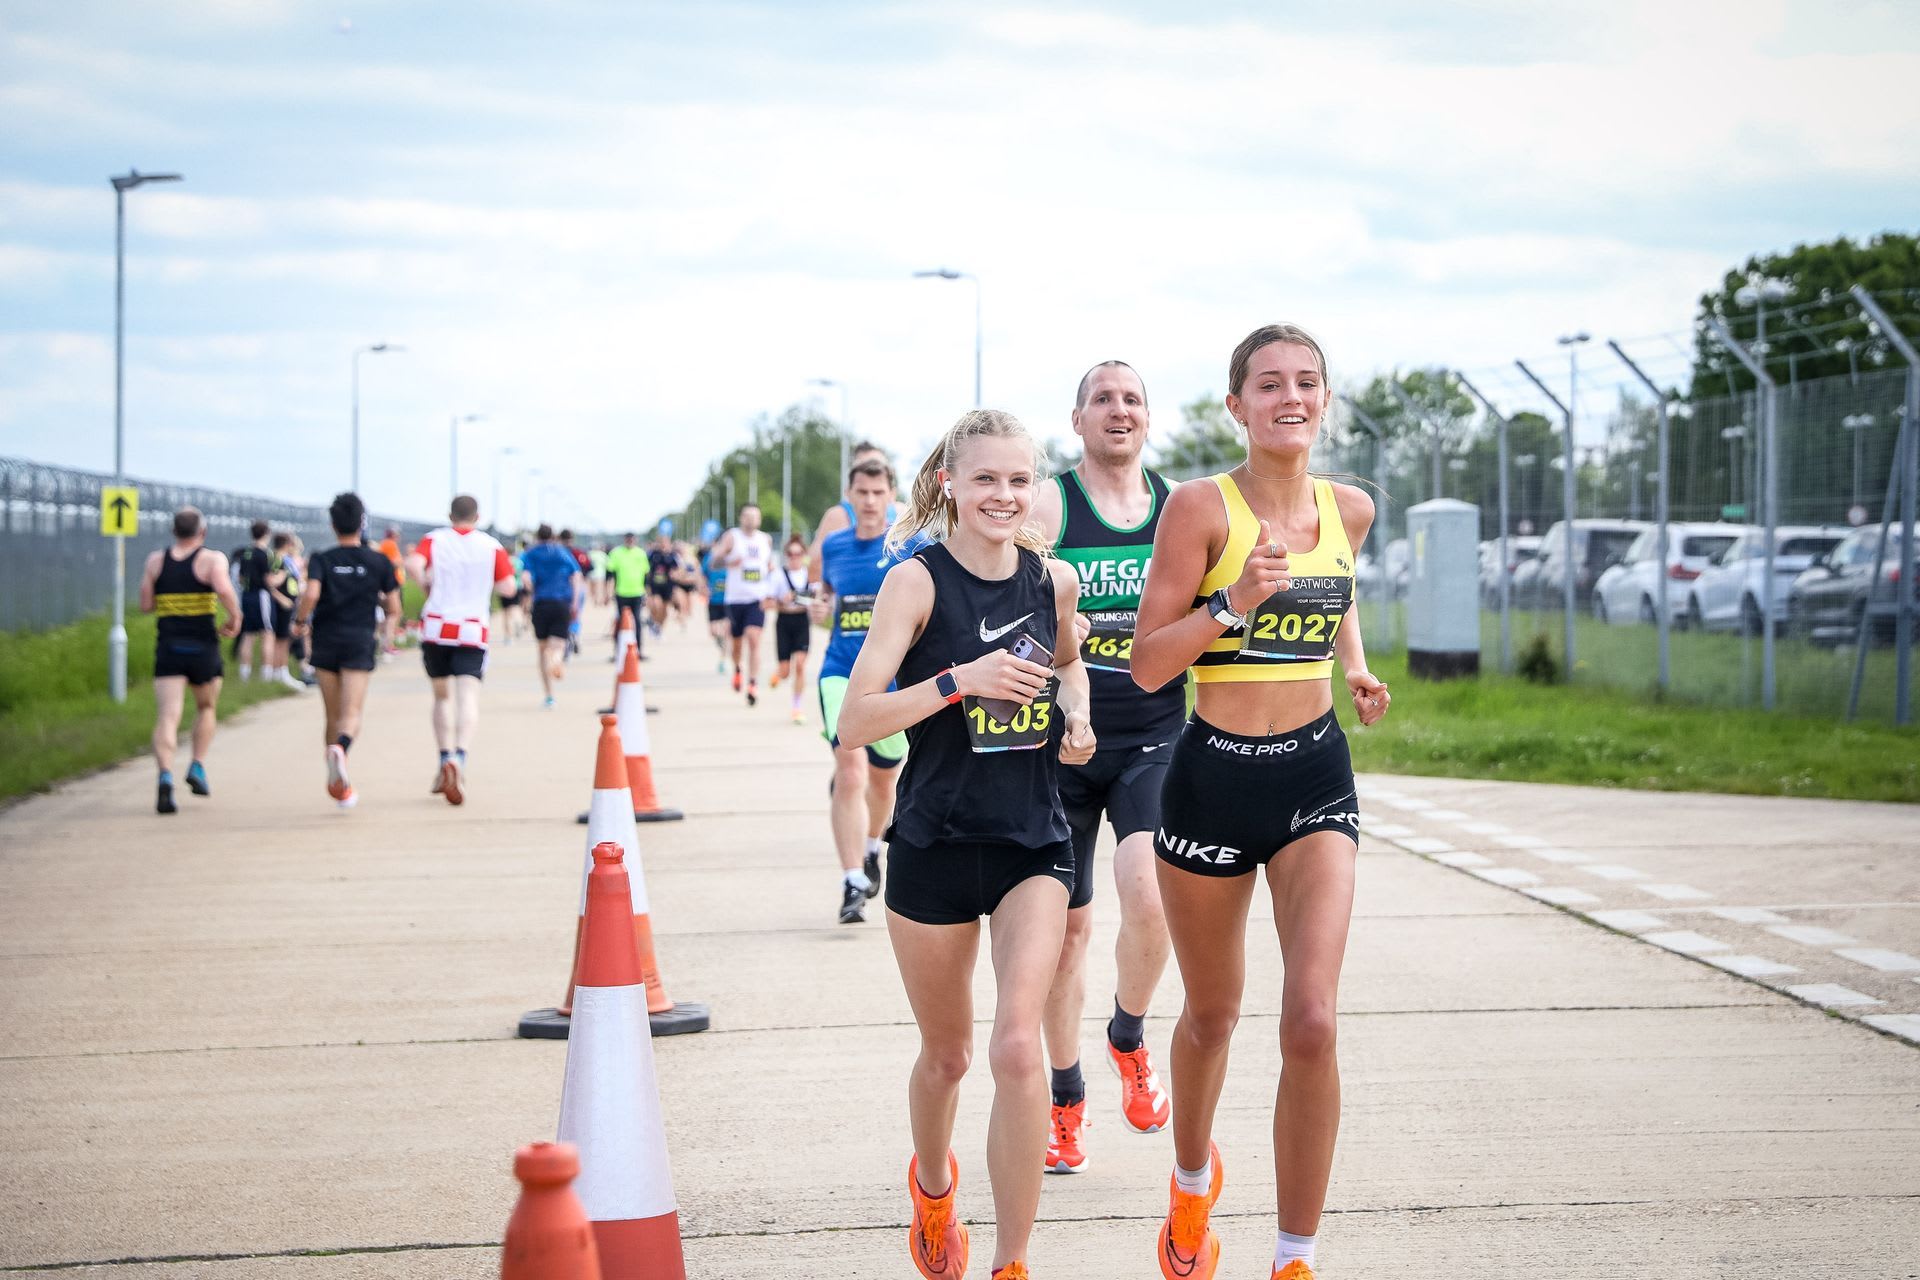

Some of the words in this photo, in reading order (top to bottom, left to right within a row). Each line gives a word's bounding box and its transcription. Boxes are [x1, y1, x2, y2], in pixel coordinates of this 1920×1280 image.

[1253, 613, 1343, 642] 2027
[1207, 735, 1255, 756] NIKE
[1255, 739, 1298, 756] PRO
[1158, 826, 1242, 864] NIKE
